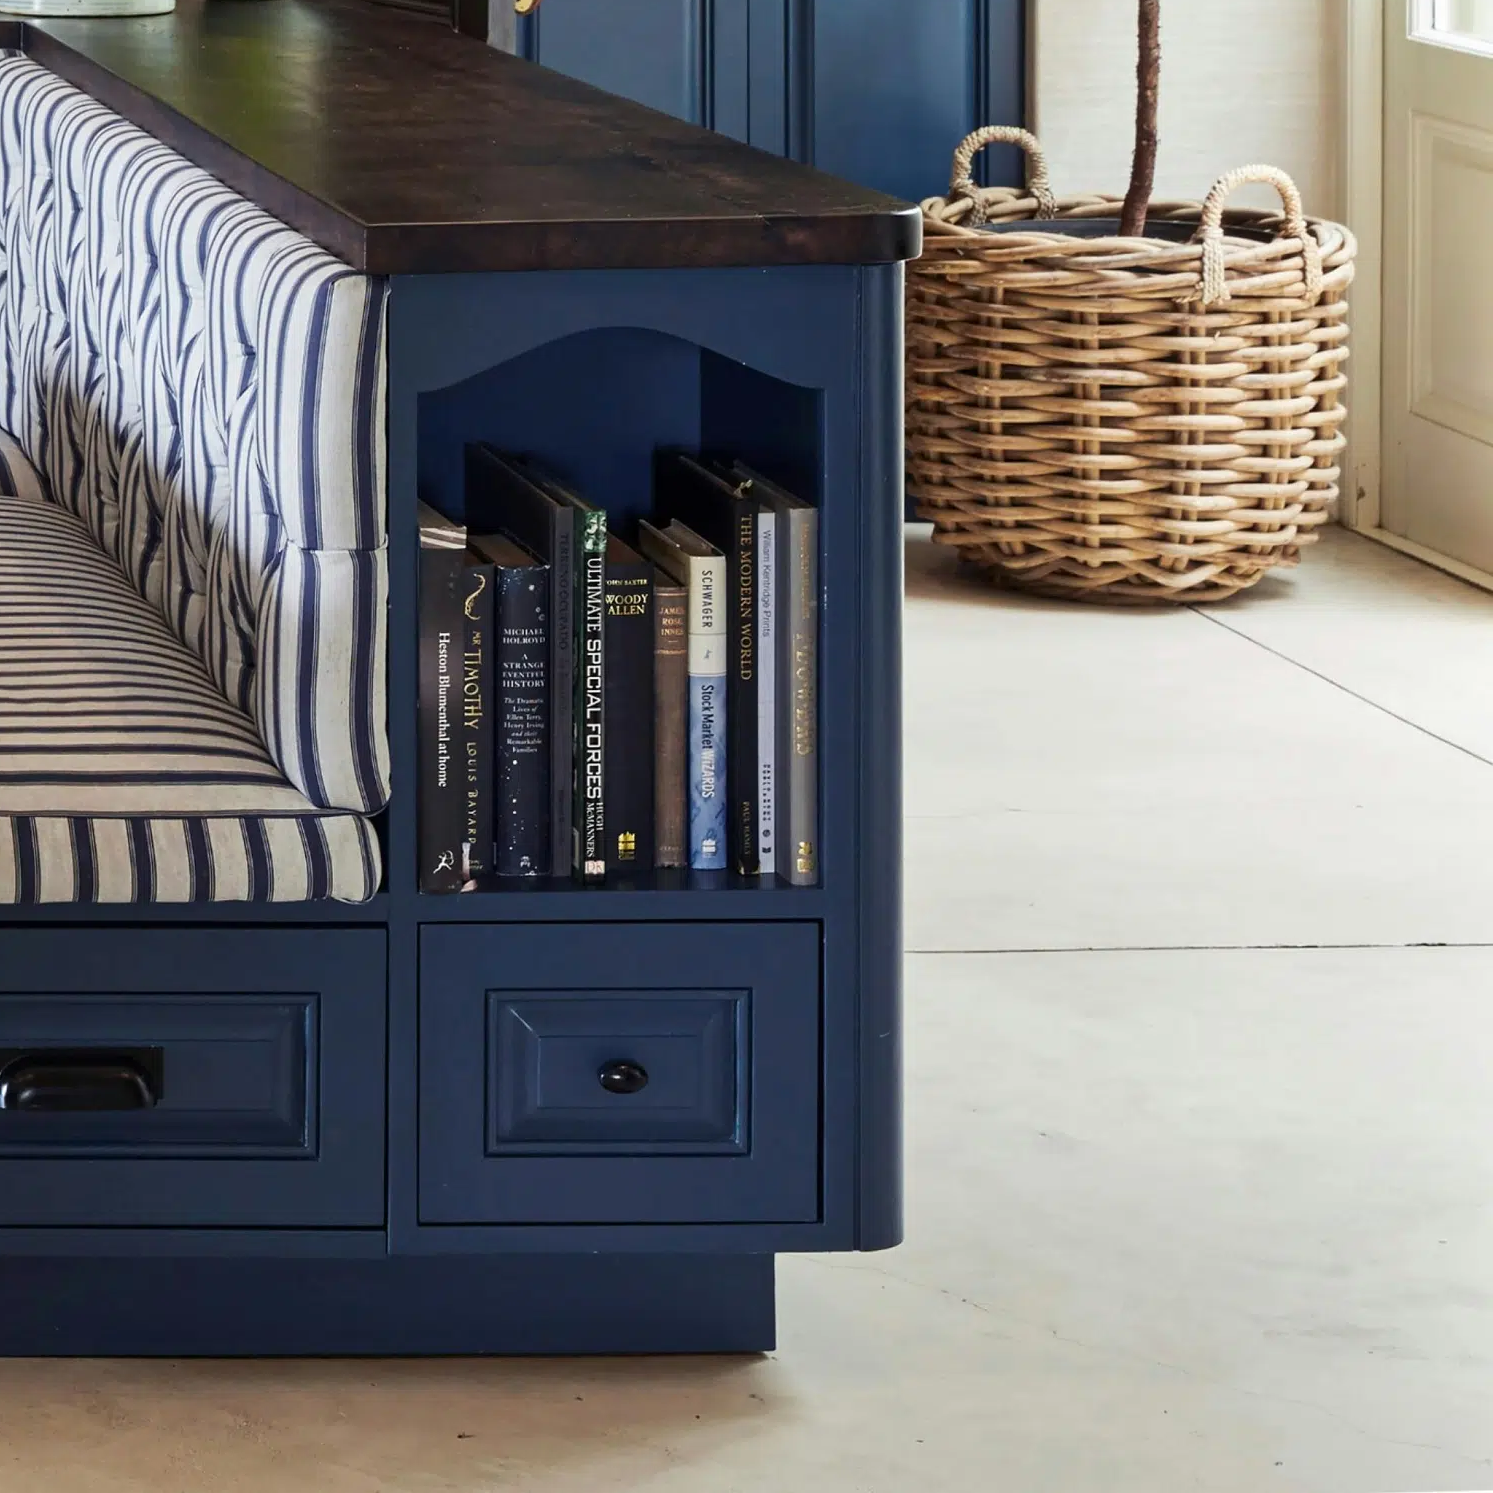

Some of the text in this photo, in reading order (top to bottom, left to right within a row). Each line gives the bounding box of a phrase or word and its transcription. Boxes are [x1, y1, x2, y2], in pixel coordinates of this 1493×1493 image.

[605, 593, 649, 604] WOODY
[701, 570, 713, 628] SCHWAGER
[740, 514, 752, 680] THE MODERN WORLD
[761, 530, 771, 638] William Kentridge Prints
[608, 604, 645, 616] ALLEN
[502, 636, 546, 645] HOLROYD
[503, 628, 544, 636] MICHAEL
[463, 649, 483, 730] TIMOTHY
[502, 670, 544, 678] EVENTFUL
[502, 680, 545, 688] HISTORY
[586, 558, 602, 799] ULTIMATE SPECIAL FORCES
[438, 632, 450, 788] Heston Blumenthal at home
[701, 684, 714, 712] Stock
[701, 713, 714, 749] Market
[466, 742, 479, 844] LOUIS BAYARD
[586, 802, 595, 858] McMANNERS
[596, 802, 604, 831] HUGH
